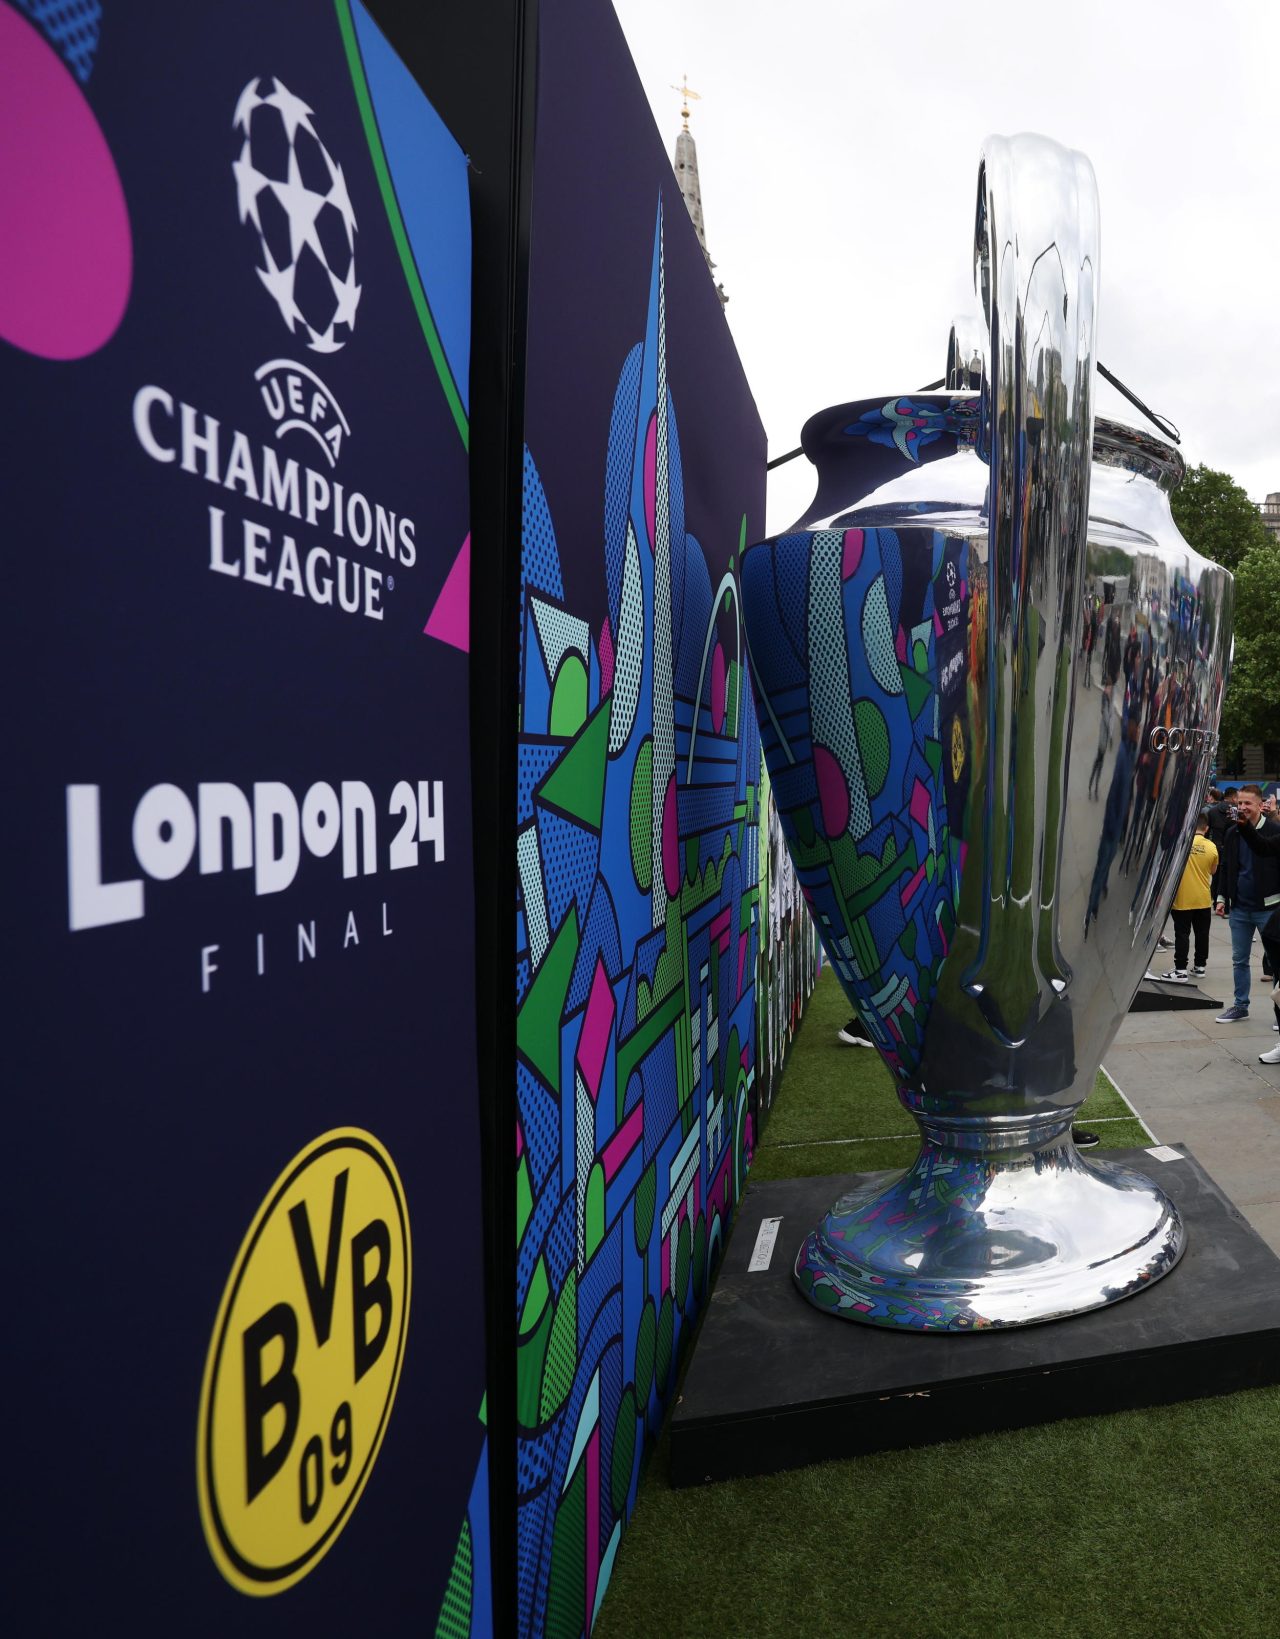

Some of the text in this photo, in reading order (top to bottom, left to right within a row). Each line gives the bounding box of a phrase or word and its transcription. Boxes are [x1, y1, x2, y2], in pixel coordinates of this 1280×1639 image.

[132, 384, 418, 570] CHAMPIONS
[257, 374, 345, 462] UEFA
[207, 504, 387, 622] LEAGUE
[389, 779, 445, 871] 24
[201, 902, 394, 993] FINAL
[242, 1166, 394, 1508] BVB
[298, 1400, 354, 1527] 09
